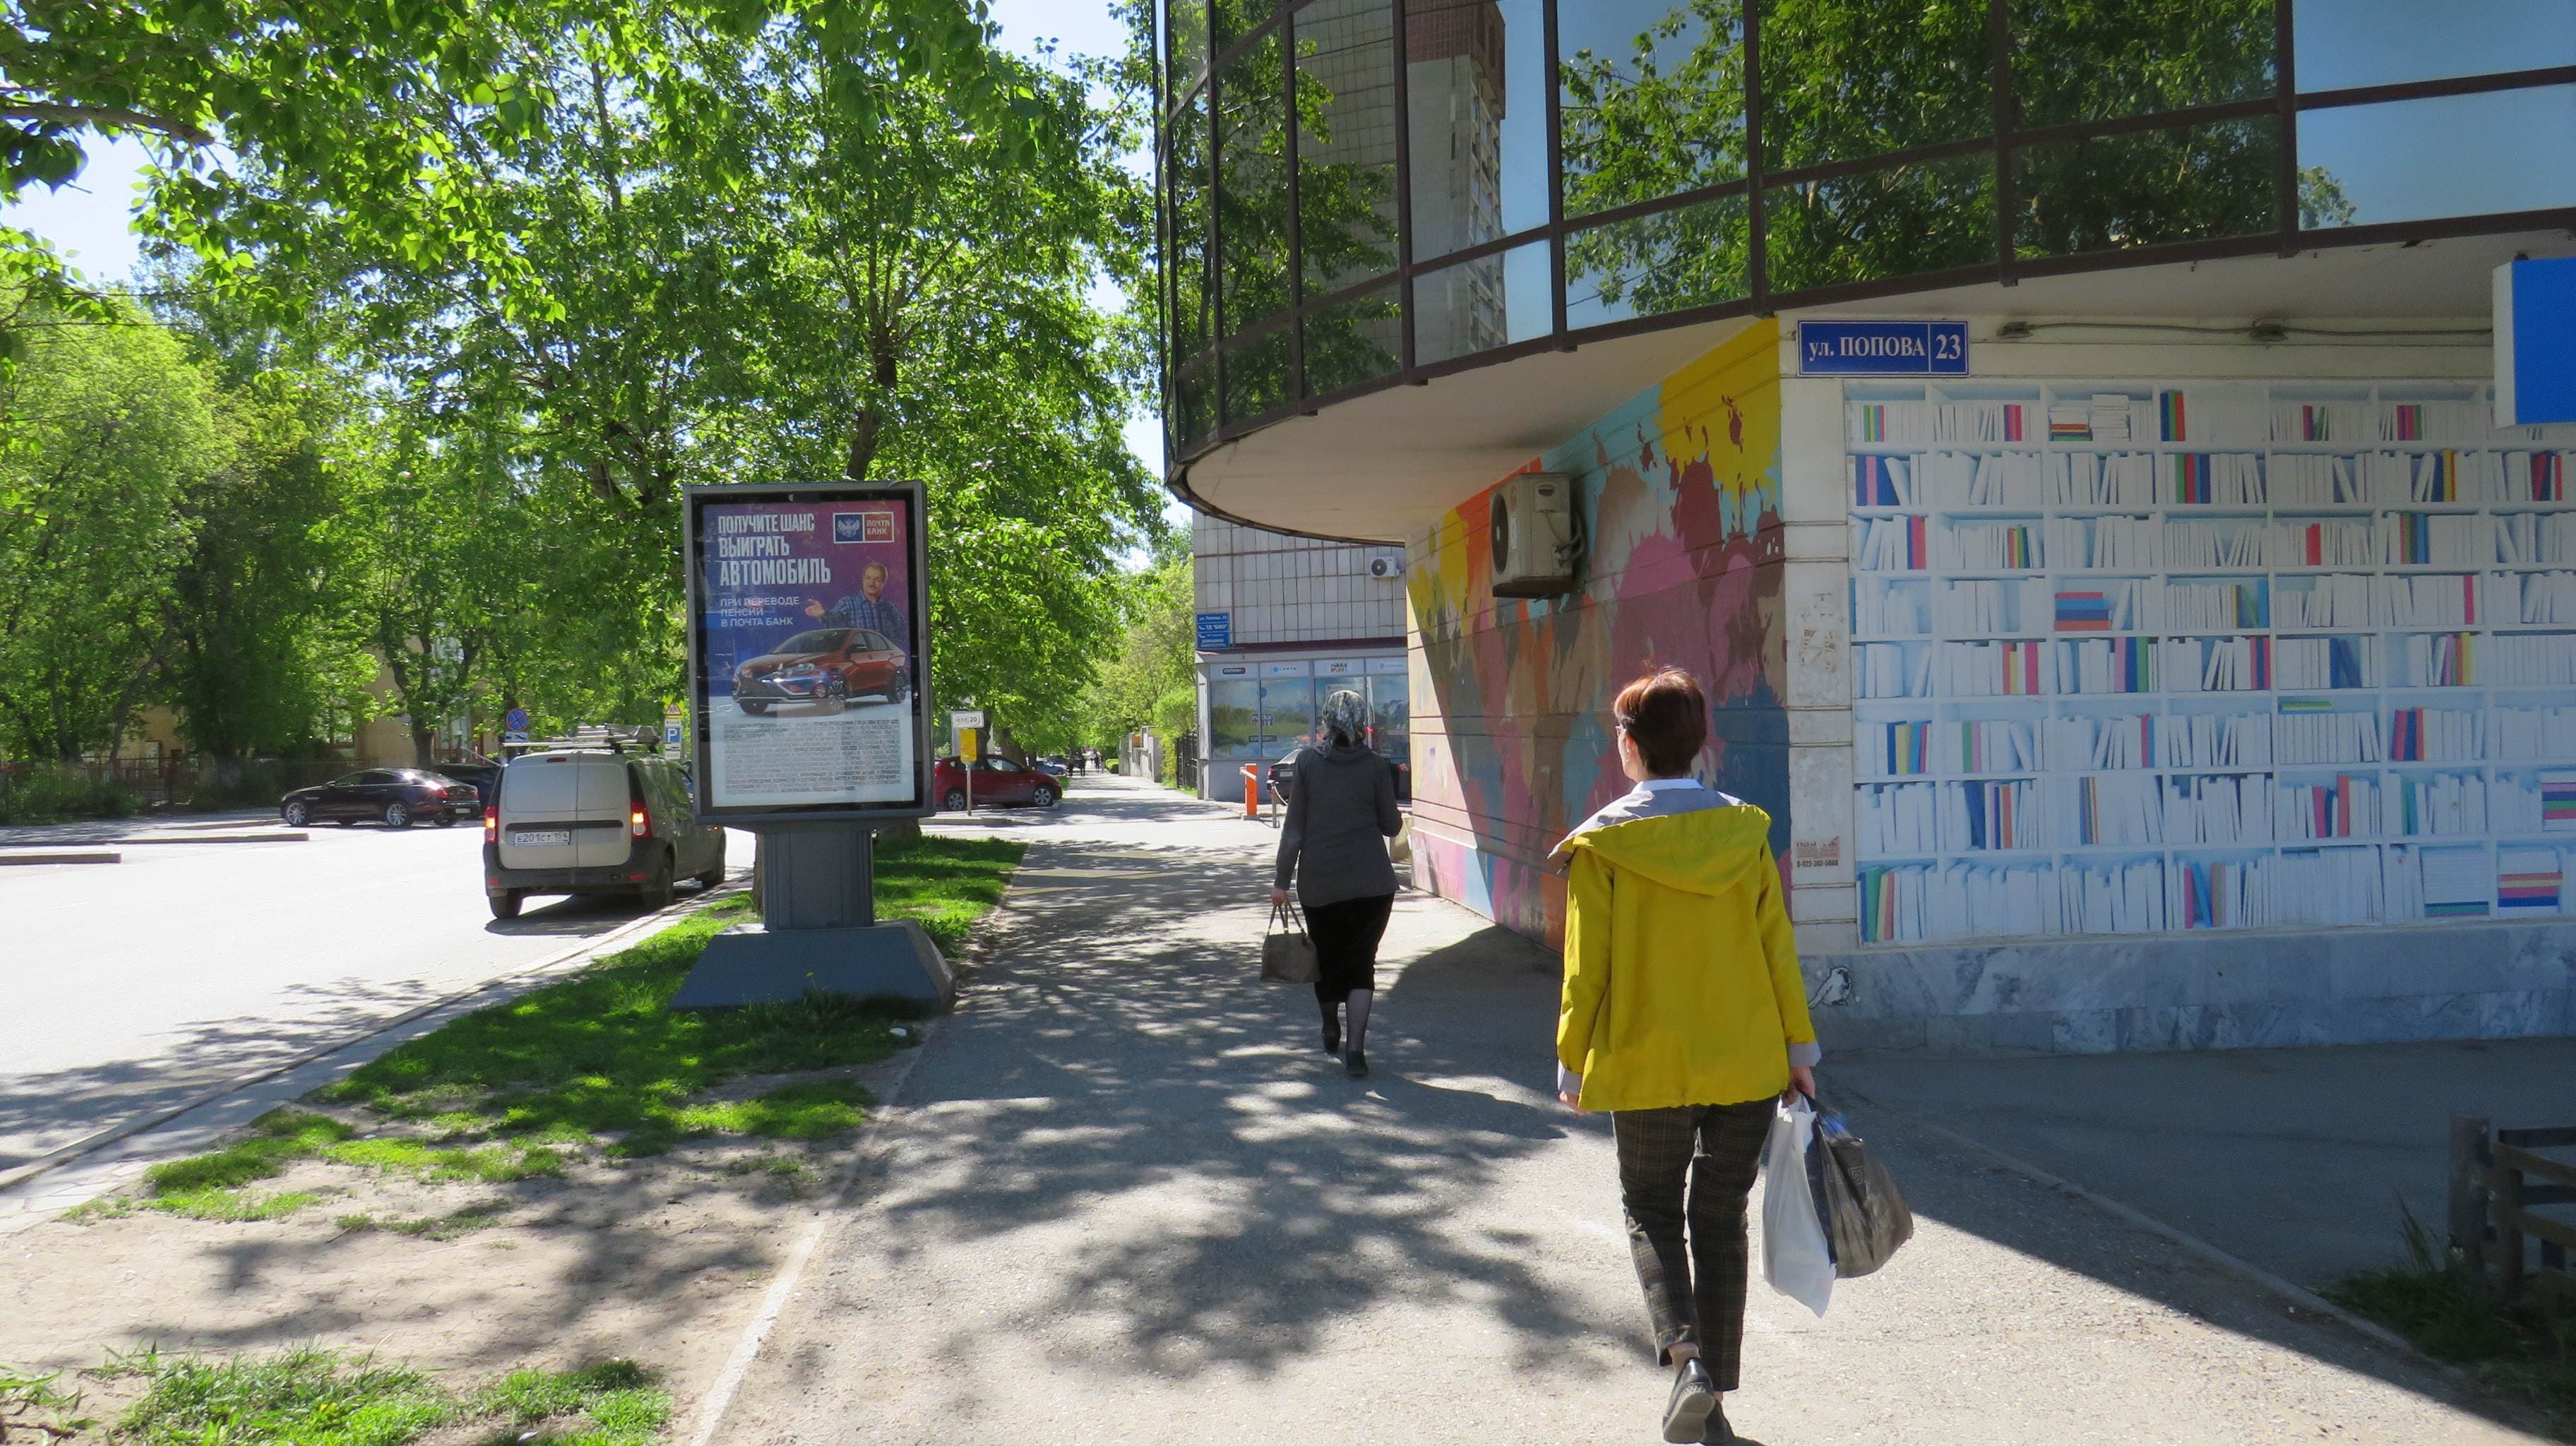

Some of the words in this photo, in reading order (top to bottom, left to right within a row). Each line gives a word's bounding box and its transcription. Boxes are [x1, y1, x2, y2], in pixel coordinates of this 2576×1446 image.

[1808, 342, 1835, 362] ул.
[1839, 337, 1926, 357] ПОПОВА
[1936, 335, 1961, 359] 23
[718, 515, 778, 534] ПОЛУЧИТЕ
[780, 513, 815, 532] ШАНС
[719, 535, 790, 558] ВЫИГРАТЬ
[720, 558, 831, 586] АВТОМОБИЛЬ
[720, 598, 741, 607] ПРИ
[744, 597, 800, 606] ПЕРЕВОДЕ
[721, 608, 763, 616] ПЕНСИИ
[730, 618, 763, 627] ПОЧТА
[766, 616, 794, 626] БАНК
[667, 728, 678, 743] P
